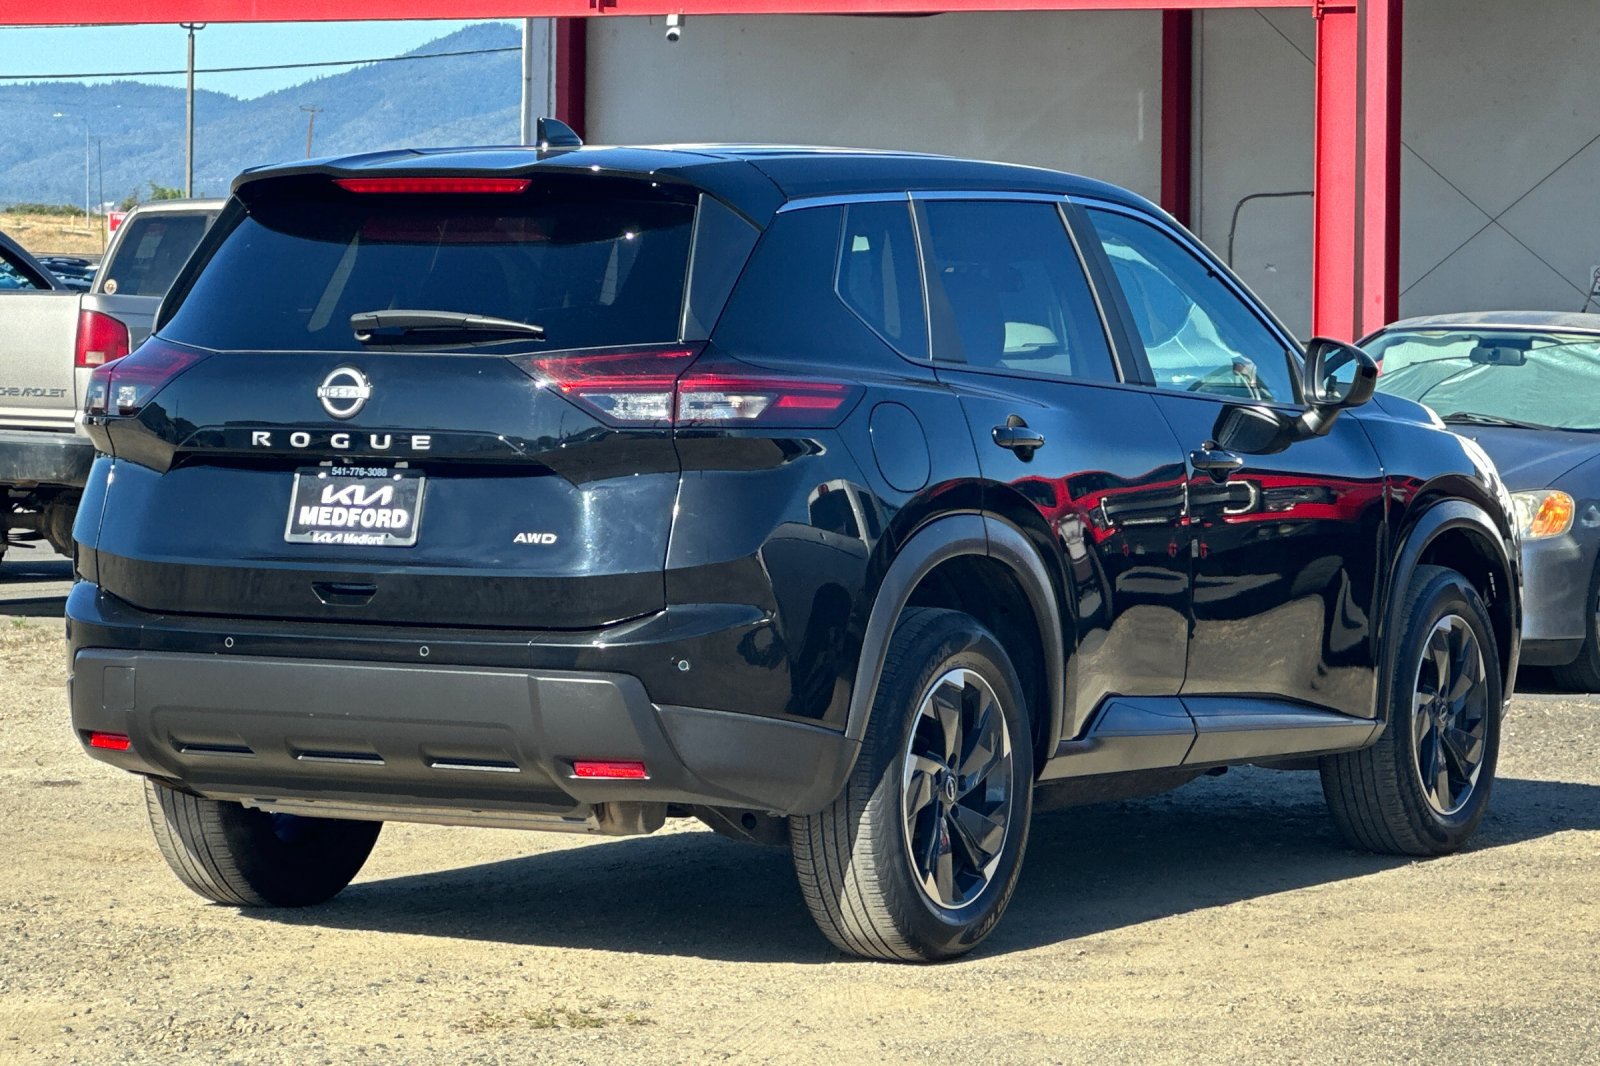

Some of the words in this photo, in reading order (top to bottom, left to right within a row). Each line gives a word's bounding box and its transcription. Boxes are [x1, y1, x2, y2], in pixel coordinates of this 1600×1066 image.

[252, 431, 431, 450] ROGUE
[331, 466, 388, 478] 541-776-3088
[321, 484, 394, 506] KIA
[298, 506, 409, 529] MEDFORD
[312, 531, 343, 544] KIA
[343, 533, 386, 545] Medford
[513, 532, 557, 545] AWD
